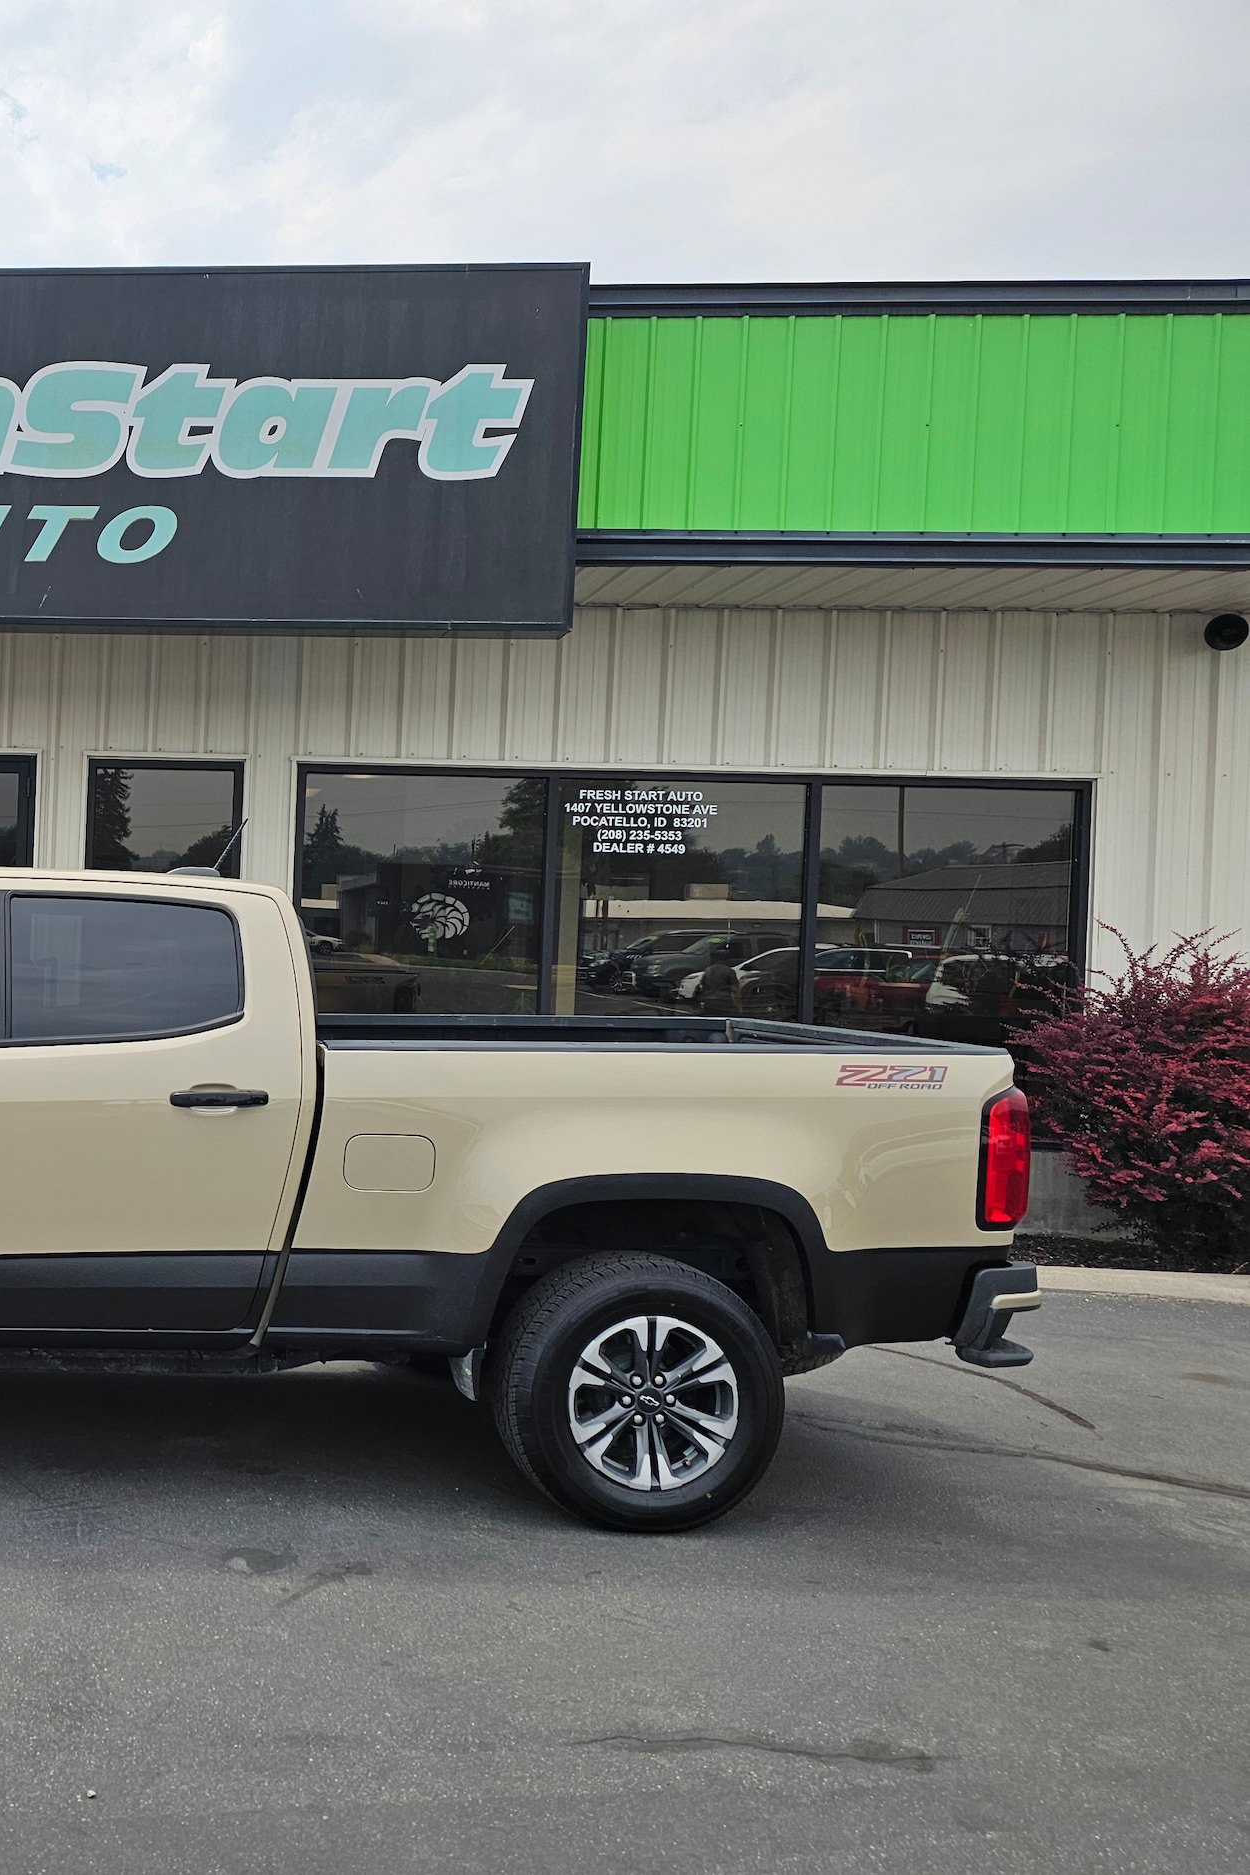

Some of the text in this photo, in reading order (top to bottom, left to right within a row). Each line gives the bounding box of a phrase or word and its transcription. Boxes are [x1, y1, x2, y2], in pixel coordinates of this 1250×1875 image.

[579, 789, 703, 802] FRESH START AUTO
[564, 803, 718, 815] 1407 YELLOWSTONE AVE
[572, 815, 708, 828] POCATELLO, ID 83201
[597, 829, 682, 842] (208) 235-5353
[593, 842, 686, 854] DEALER # 4549
[835, 1065, 948, 1087] Z71
